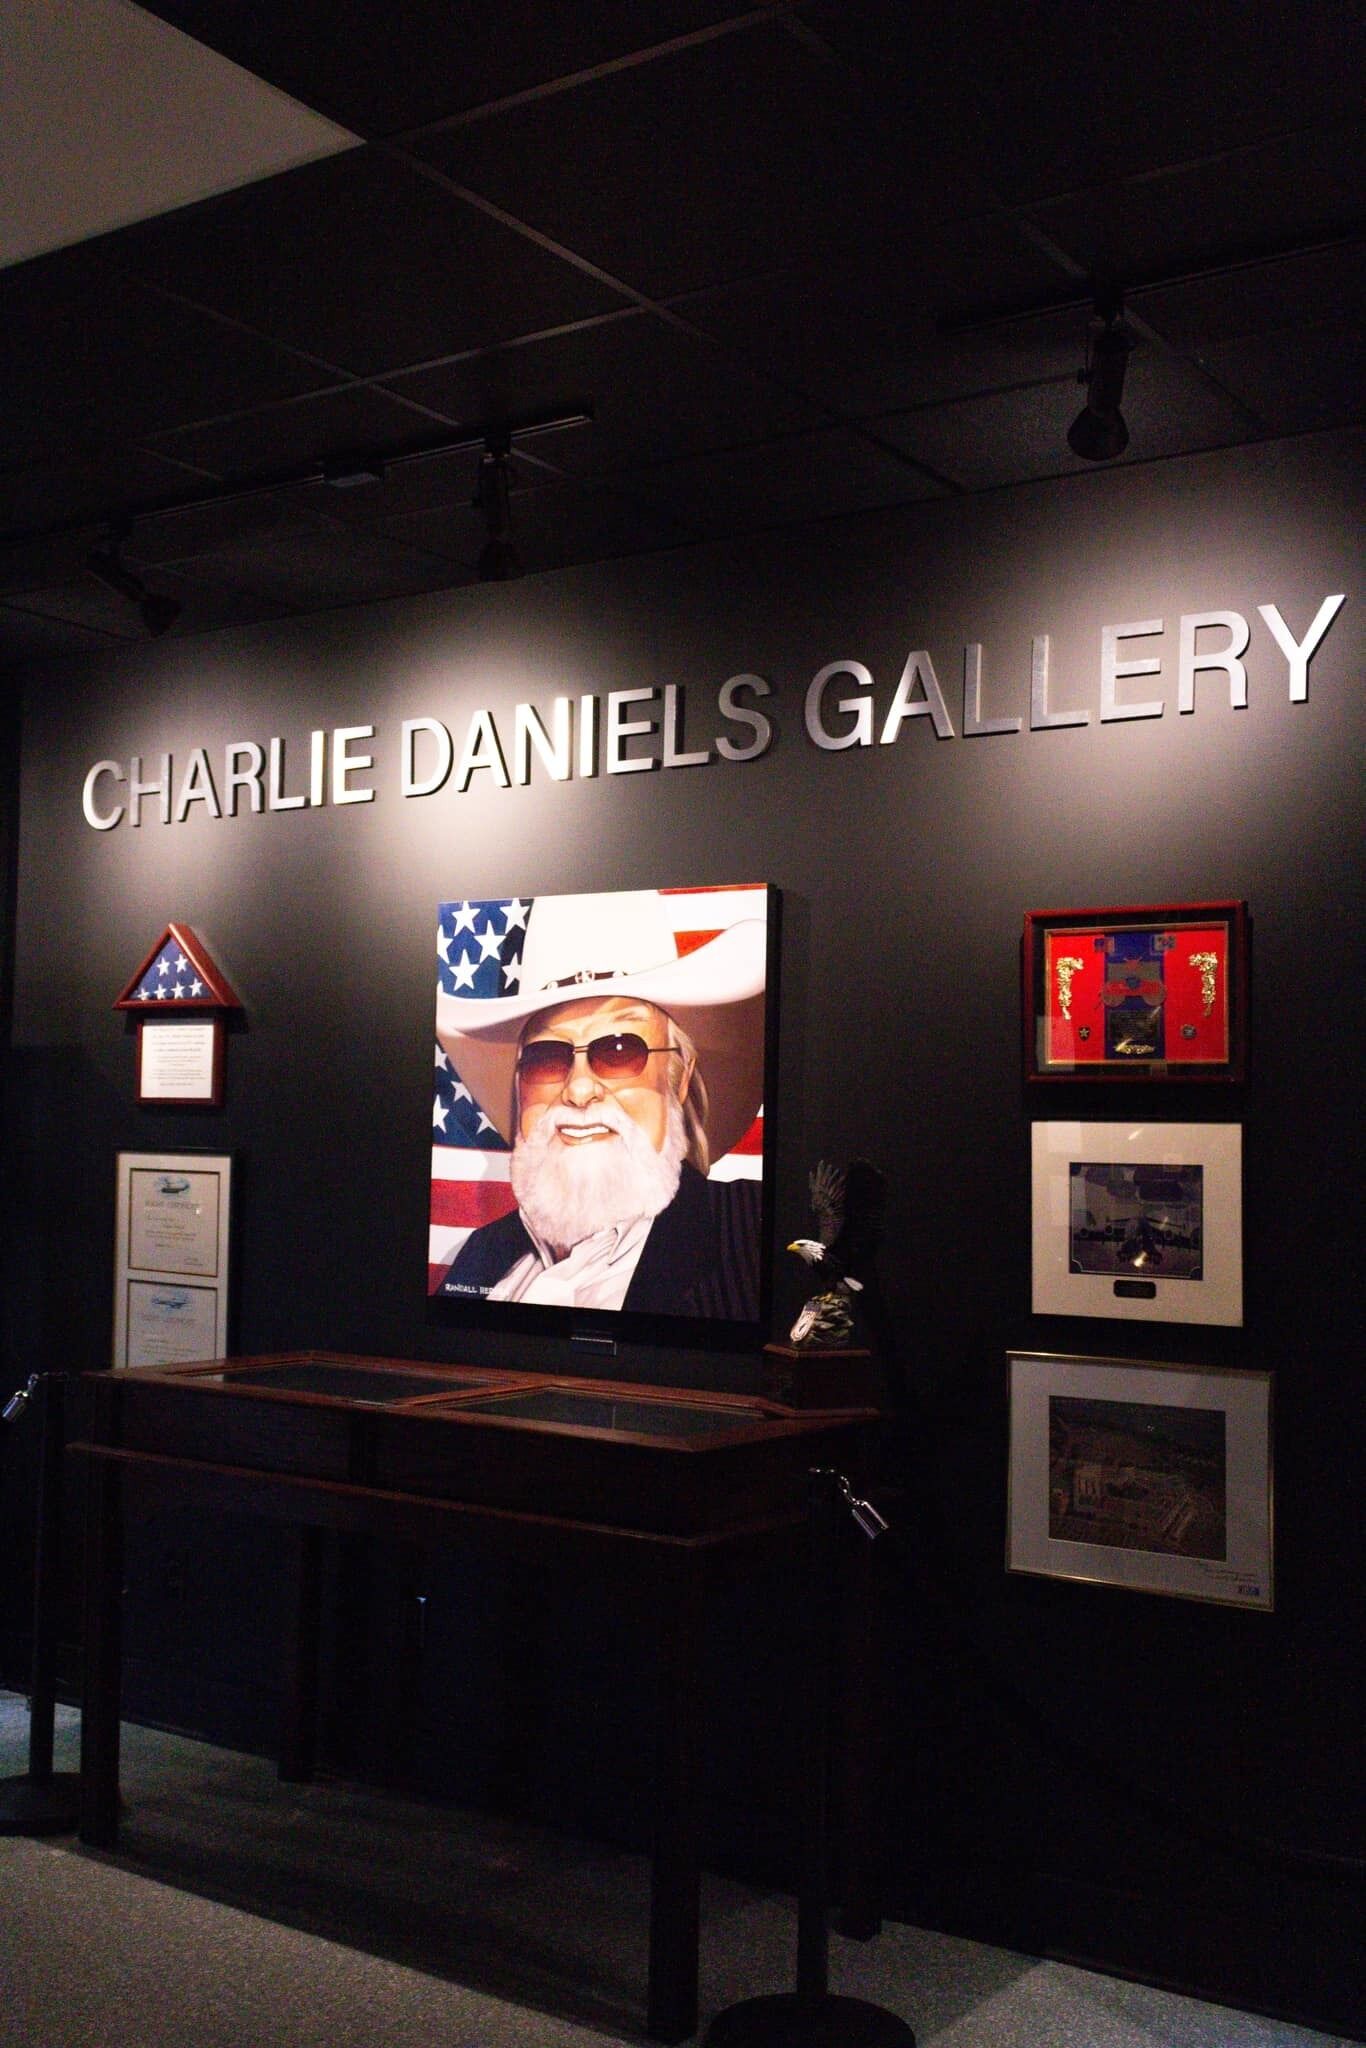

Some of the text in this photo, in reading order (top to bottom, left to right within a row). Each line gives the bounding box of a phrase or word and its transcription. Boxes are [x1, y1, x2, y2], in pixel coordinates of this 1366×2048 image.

[82, 594, 1346, 831] CHARLIE DANIELS GALLERY
[445, 1283, 478, 1293] RANDALL
